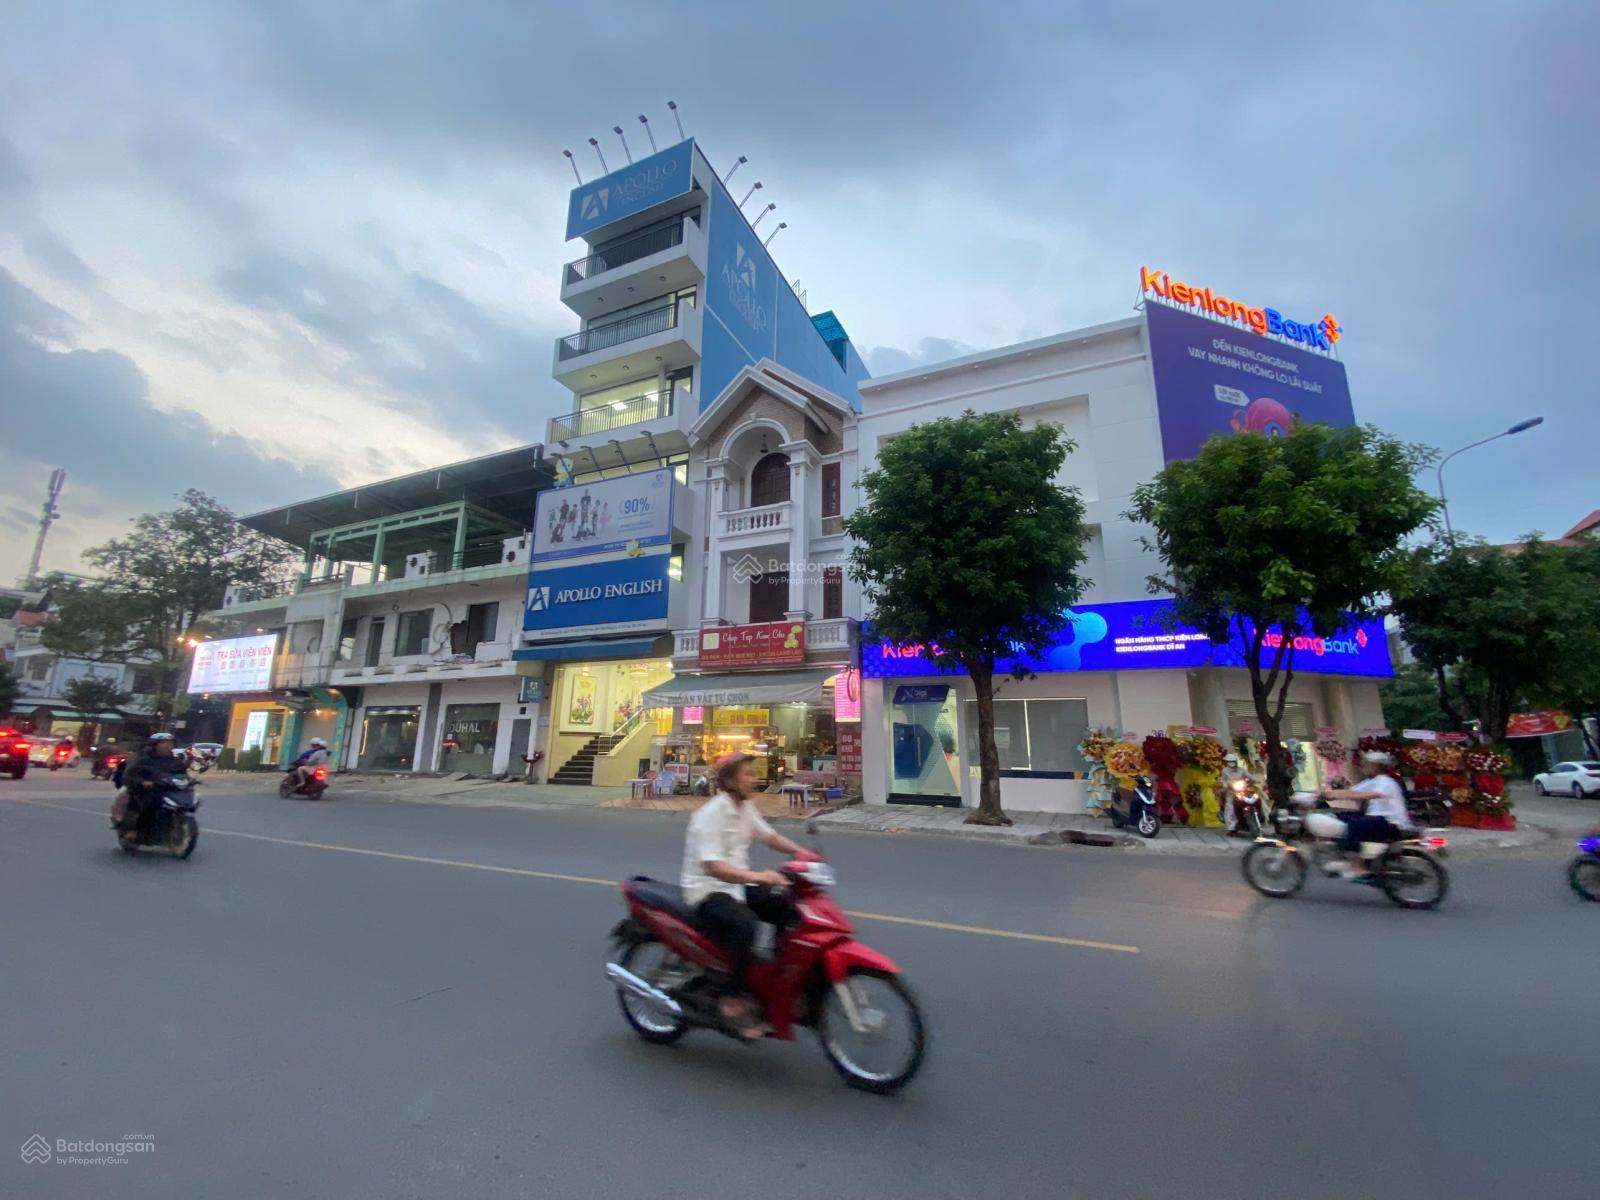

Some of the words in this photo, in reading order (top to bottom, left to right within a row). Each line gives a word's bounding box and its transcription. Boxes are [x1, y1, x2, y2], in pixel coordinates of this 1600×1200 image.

[1140, 266, 1329, 350] KienlongBank
[1212, 338, 1233, 352] ĐẾN
[1187, 346, 1206, 361] VAY
[1207, 353, 1241, 371] NHANH
[1241, 360, 1275, 380] KHÔNG
[1275, 372, 1288, 384] LO
[624, 497, 650, 514] 90%
[555, 586, 601, 604] APOLLO
[605, 579, 663, 598] ENGLISH
